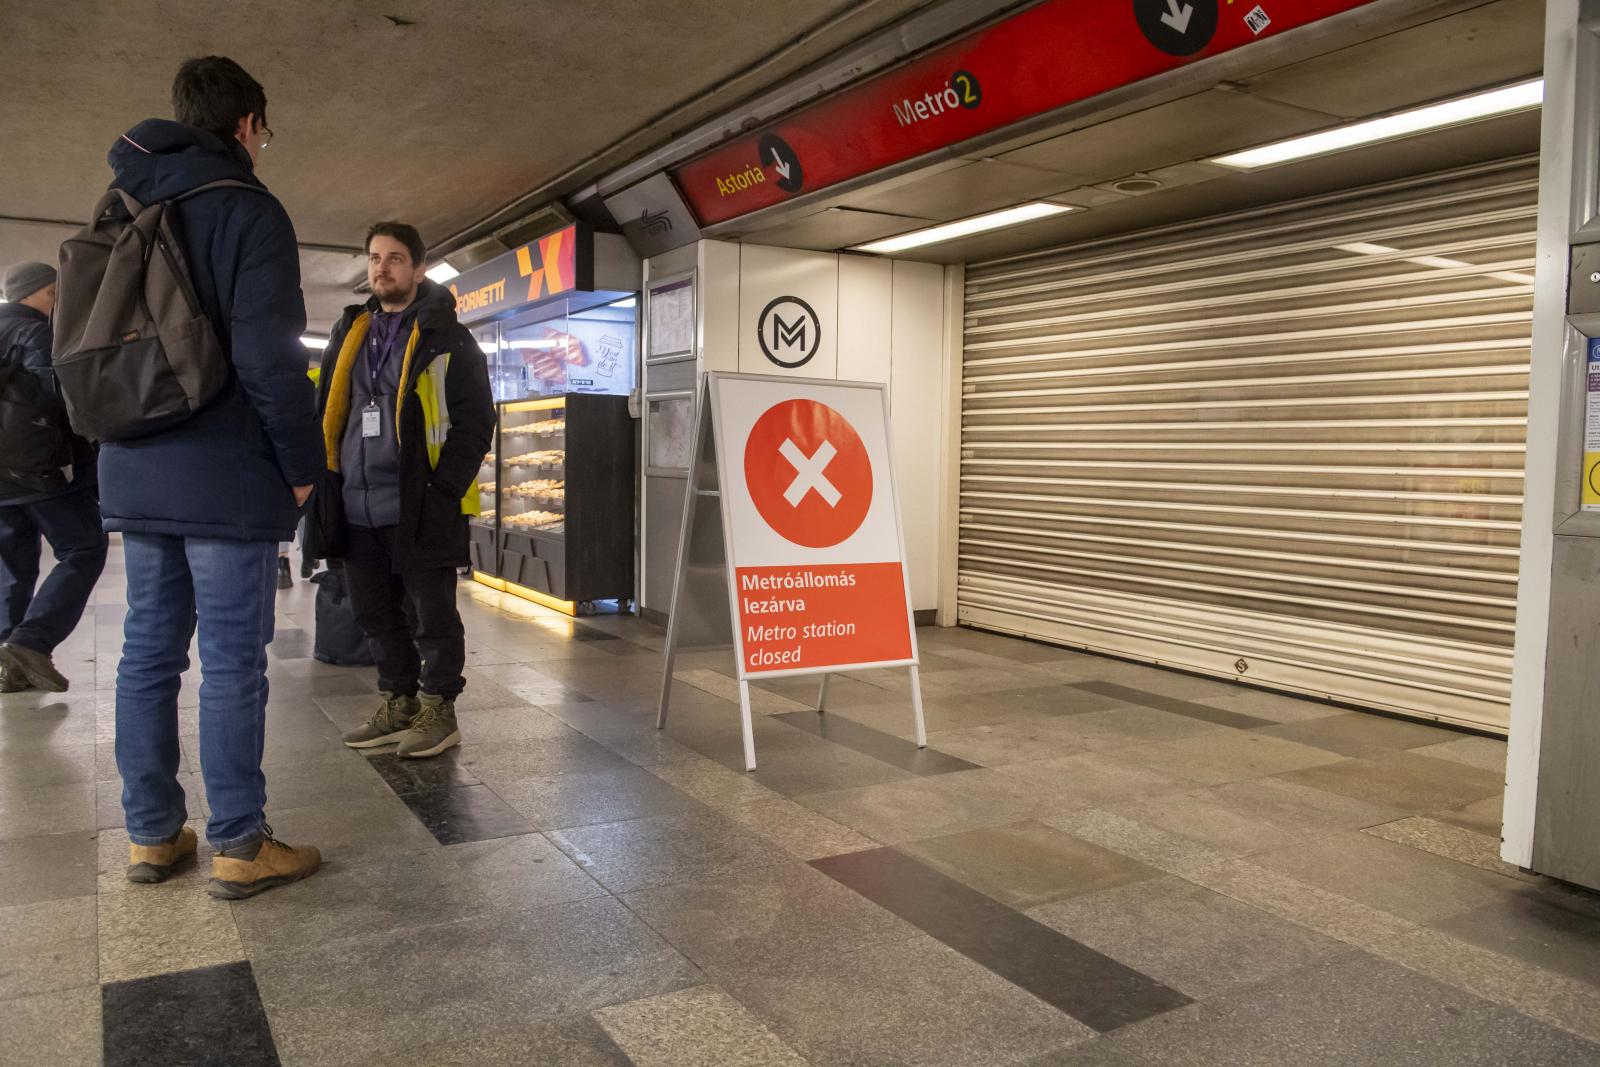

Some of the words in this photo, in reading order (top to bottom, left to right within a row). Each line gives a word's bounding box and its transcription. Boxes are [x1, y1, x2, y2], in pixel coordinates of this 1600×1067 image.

[892, 82, 959, 127] Metró
[956, 74, 977, 104] 2
[715, 163, 766, 197] Astoria
[456, 278, 506, 314] FORNETTI
[741, 570, 857, 591] Metróállomás
[743, 595, 806, 614] lezárva
[747, 625, 797, 643] Metro
[802, 620, 856, 639] station
[749, 645, 802, 667] closed
